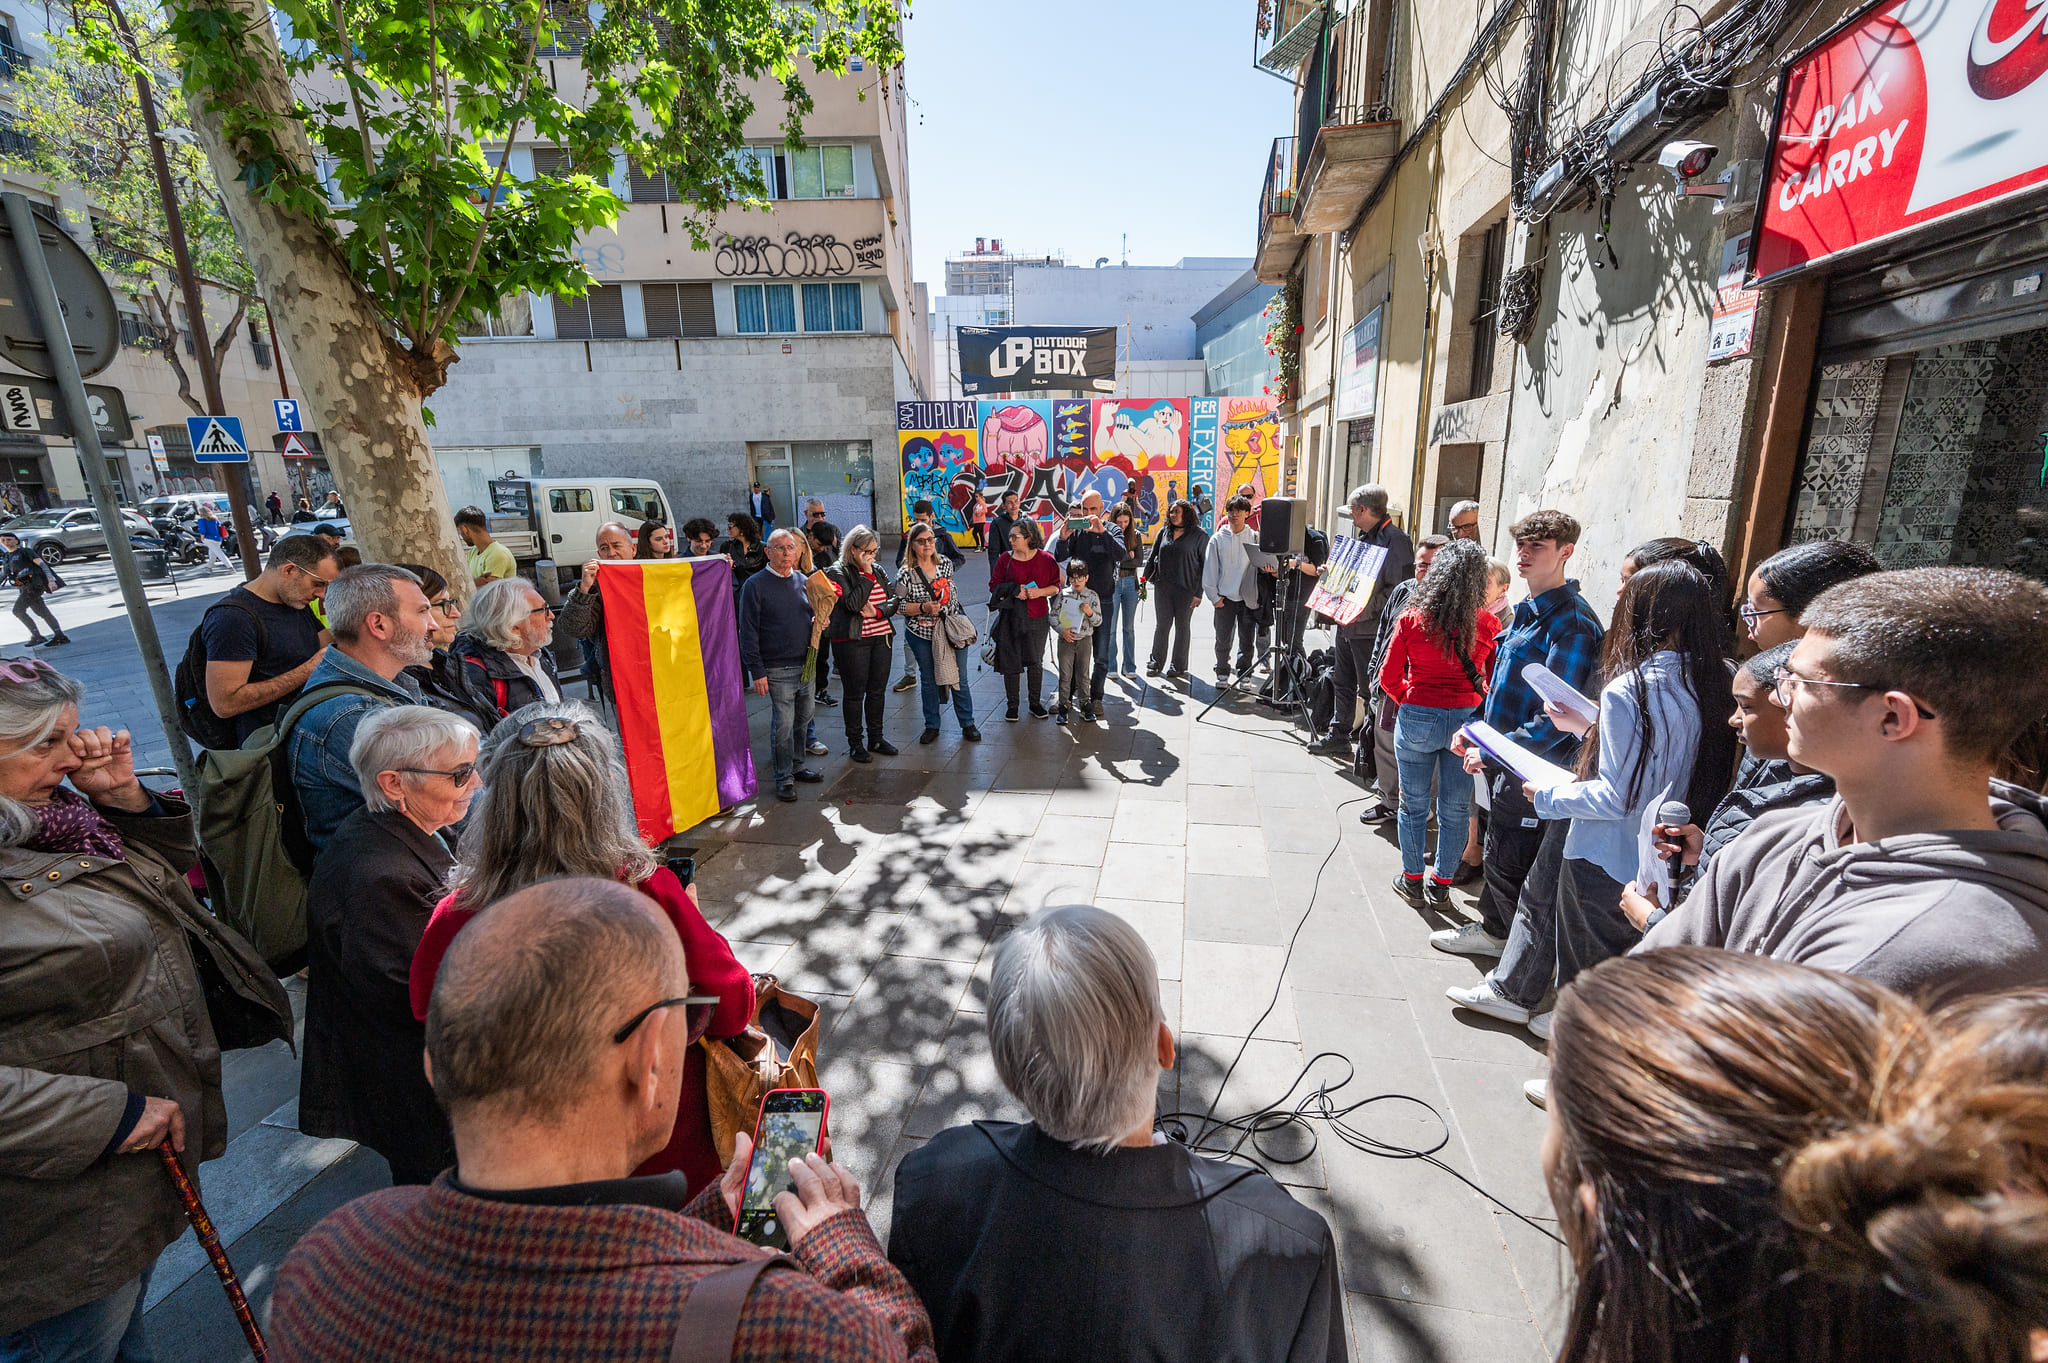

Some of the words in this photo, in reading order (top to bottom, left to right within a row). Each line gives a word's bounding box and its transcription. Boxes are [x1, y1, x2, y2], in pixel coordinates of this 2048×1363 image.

[1810, 72, 1890, 149] PAK
[1780, 119, 1909, 211] CARRY
[856, 249, 884, 263] BLOND
[1034, 336, 1088, 349] OUTDOOR
[1034, 349, 1088, 377] BOX
[277, 401, 295, 419] P
[900, 402, 914, 429] SACA
[914, 403, 932, 429] TU
[934, 402, 977, 429] PLUMA
[1193, 400, 1217, 414] PER
